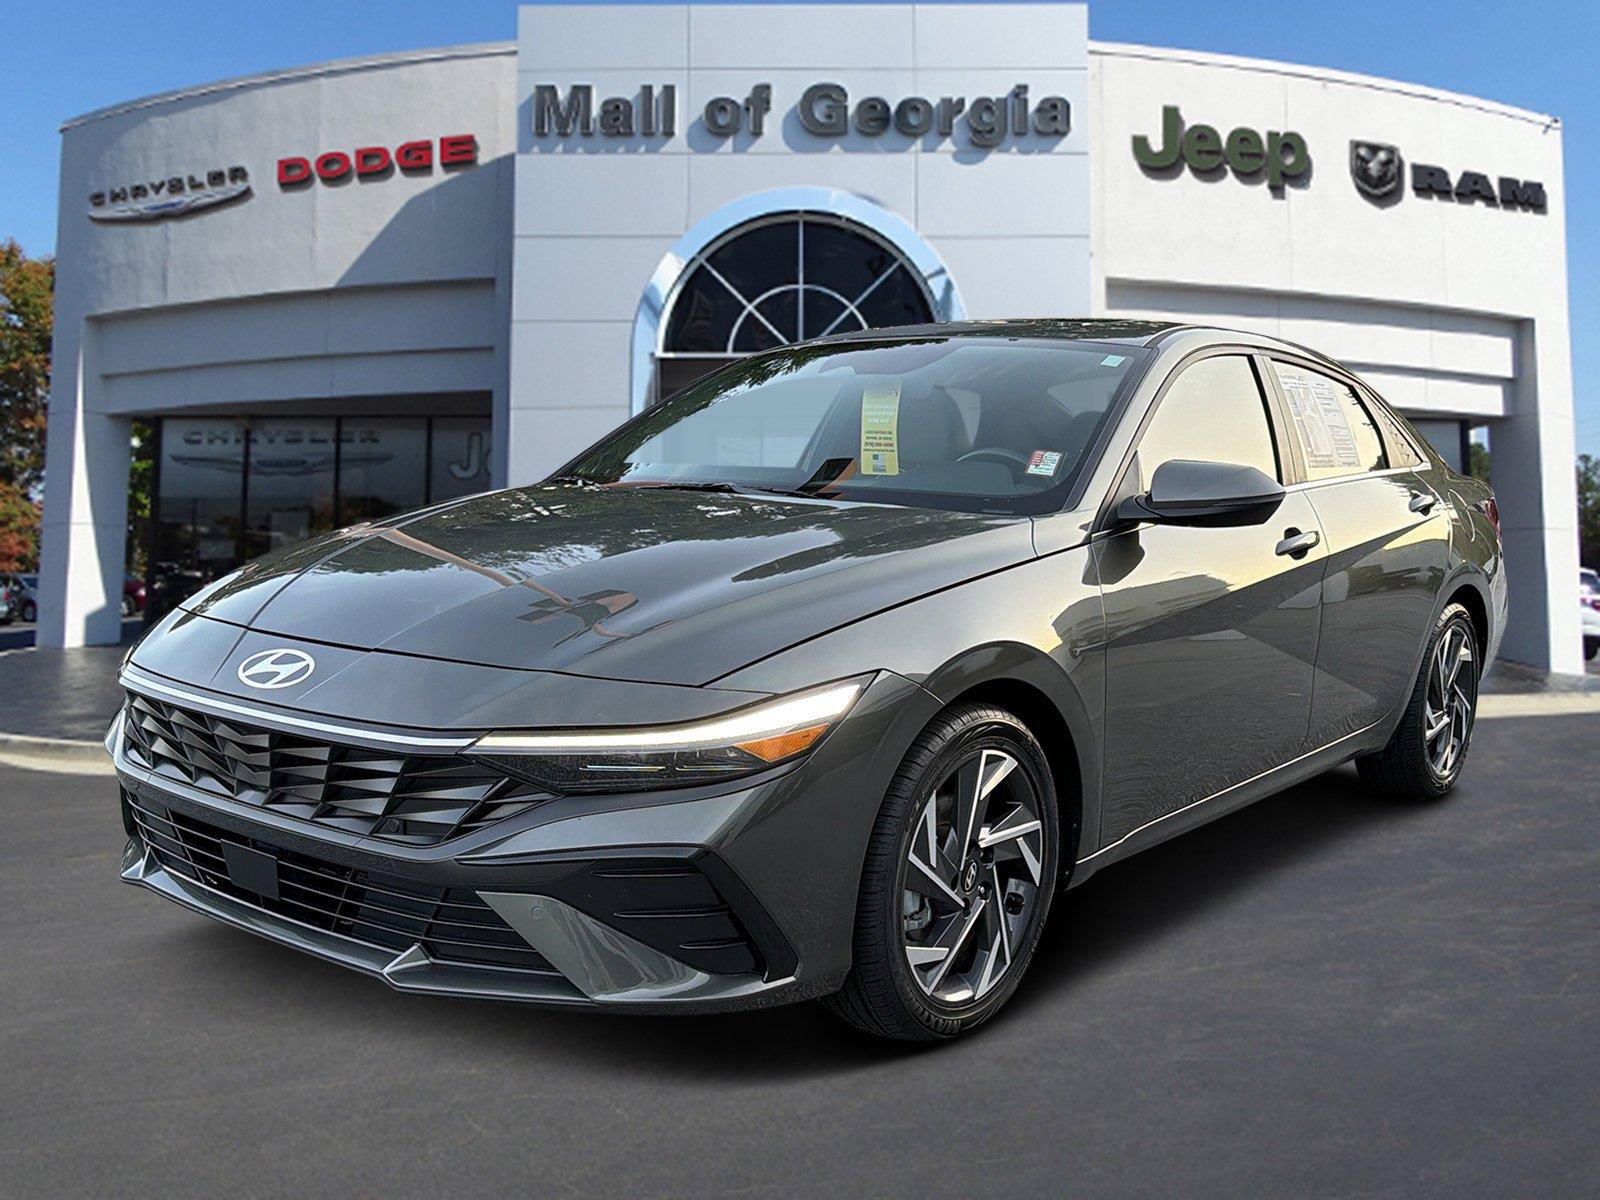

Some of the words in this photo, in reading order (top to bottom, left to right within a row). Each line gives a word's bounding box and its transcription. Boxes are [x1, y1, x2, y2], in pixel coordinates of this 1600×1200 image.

[532, 84, 676, 136] Mall
[703, 82, 772, 136] of
[799, 82, 1071, 147] Georgia
[276, 134, 477, 186] DODGE
[1131, 104, 1311, 194] Jeep
[88, 165, 250, 207] CHRYSLER
[1411, 162, 1549, 214] RAM
